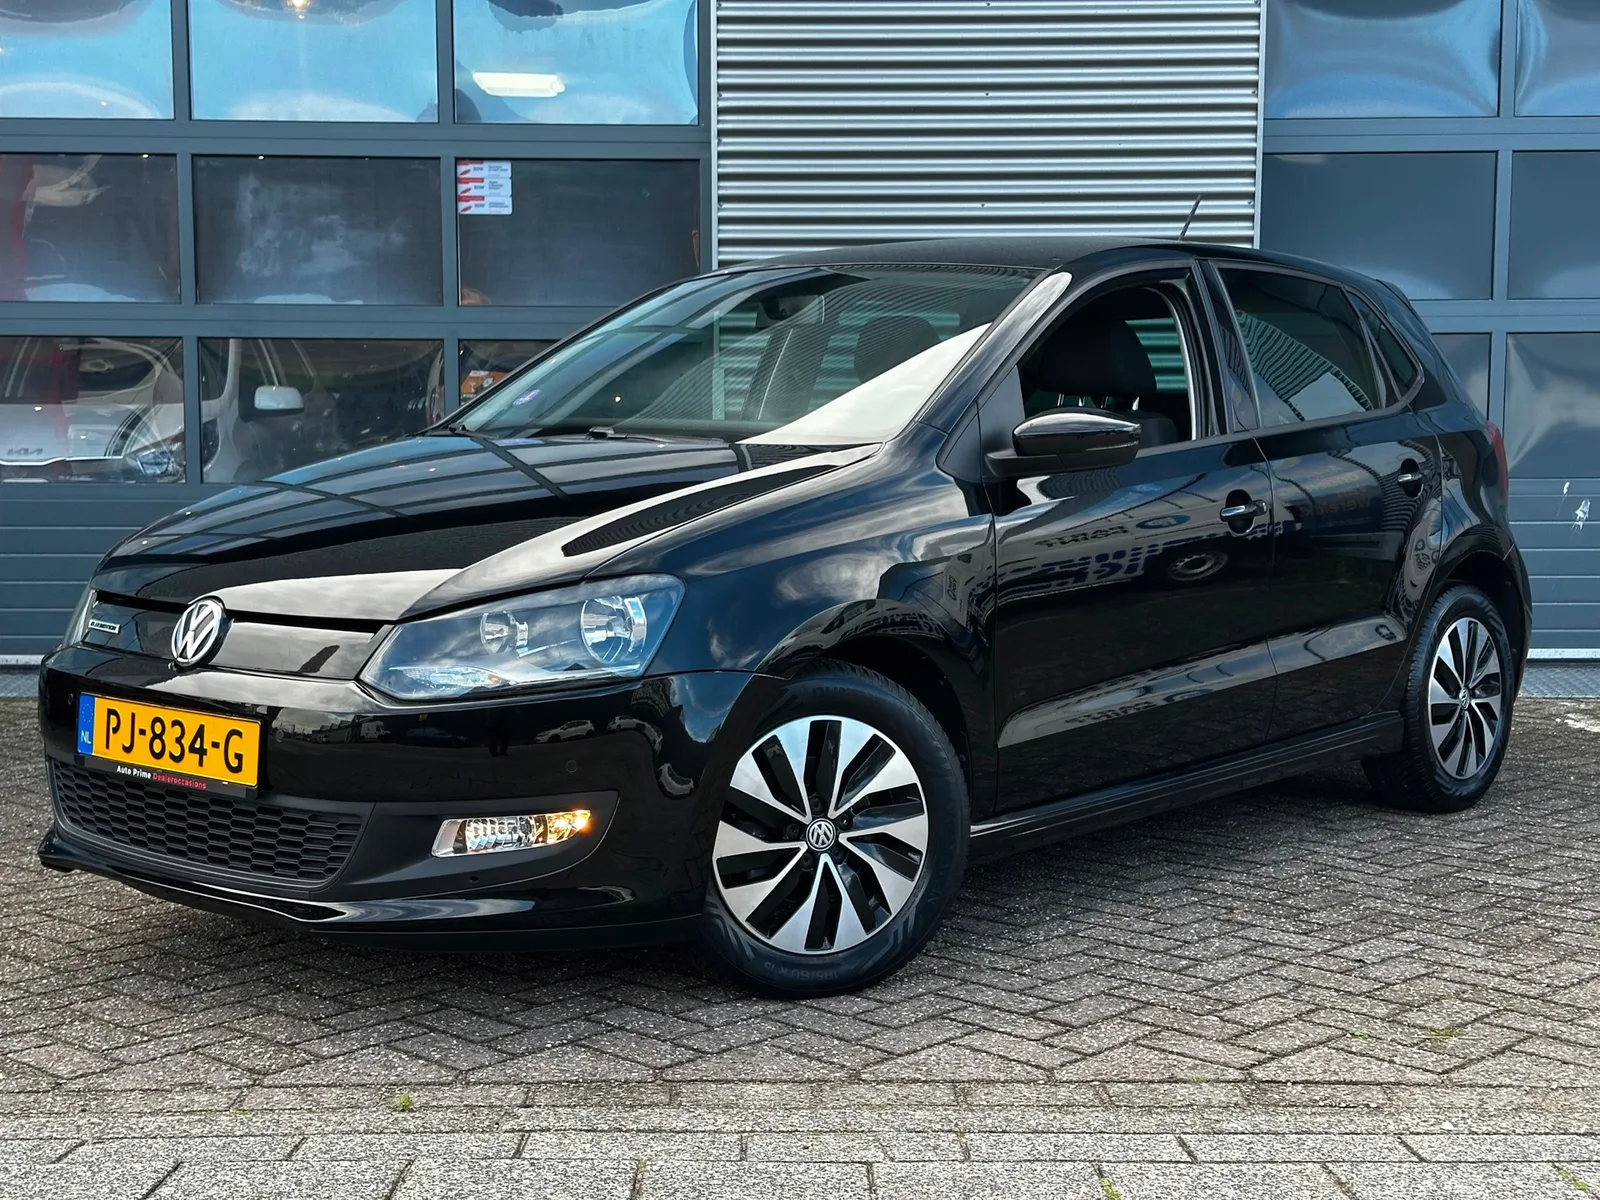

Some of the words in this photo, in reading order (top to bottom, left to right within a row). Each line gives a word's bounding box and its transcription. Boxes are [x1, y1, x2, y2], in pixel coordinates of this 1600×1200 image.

[80, 729, 92, 745] NL
[105, 708, 244, 774] PJ-834-G
[116, 765, 132, 776] Auto
[132, 768, 152, 780] Prime
[152, 772, 207, 790] Dealeroccasions
